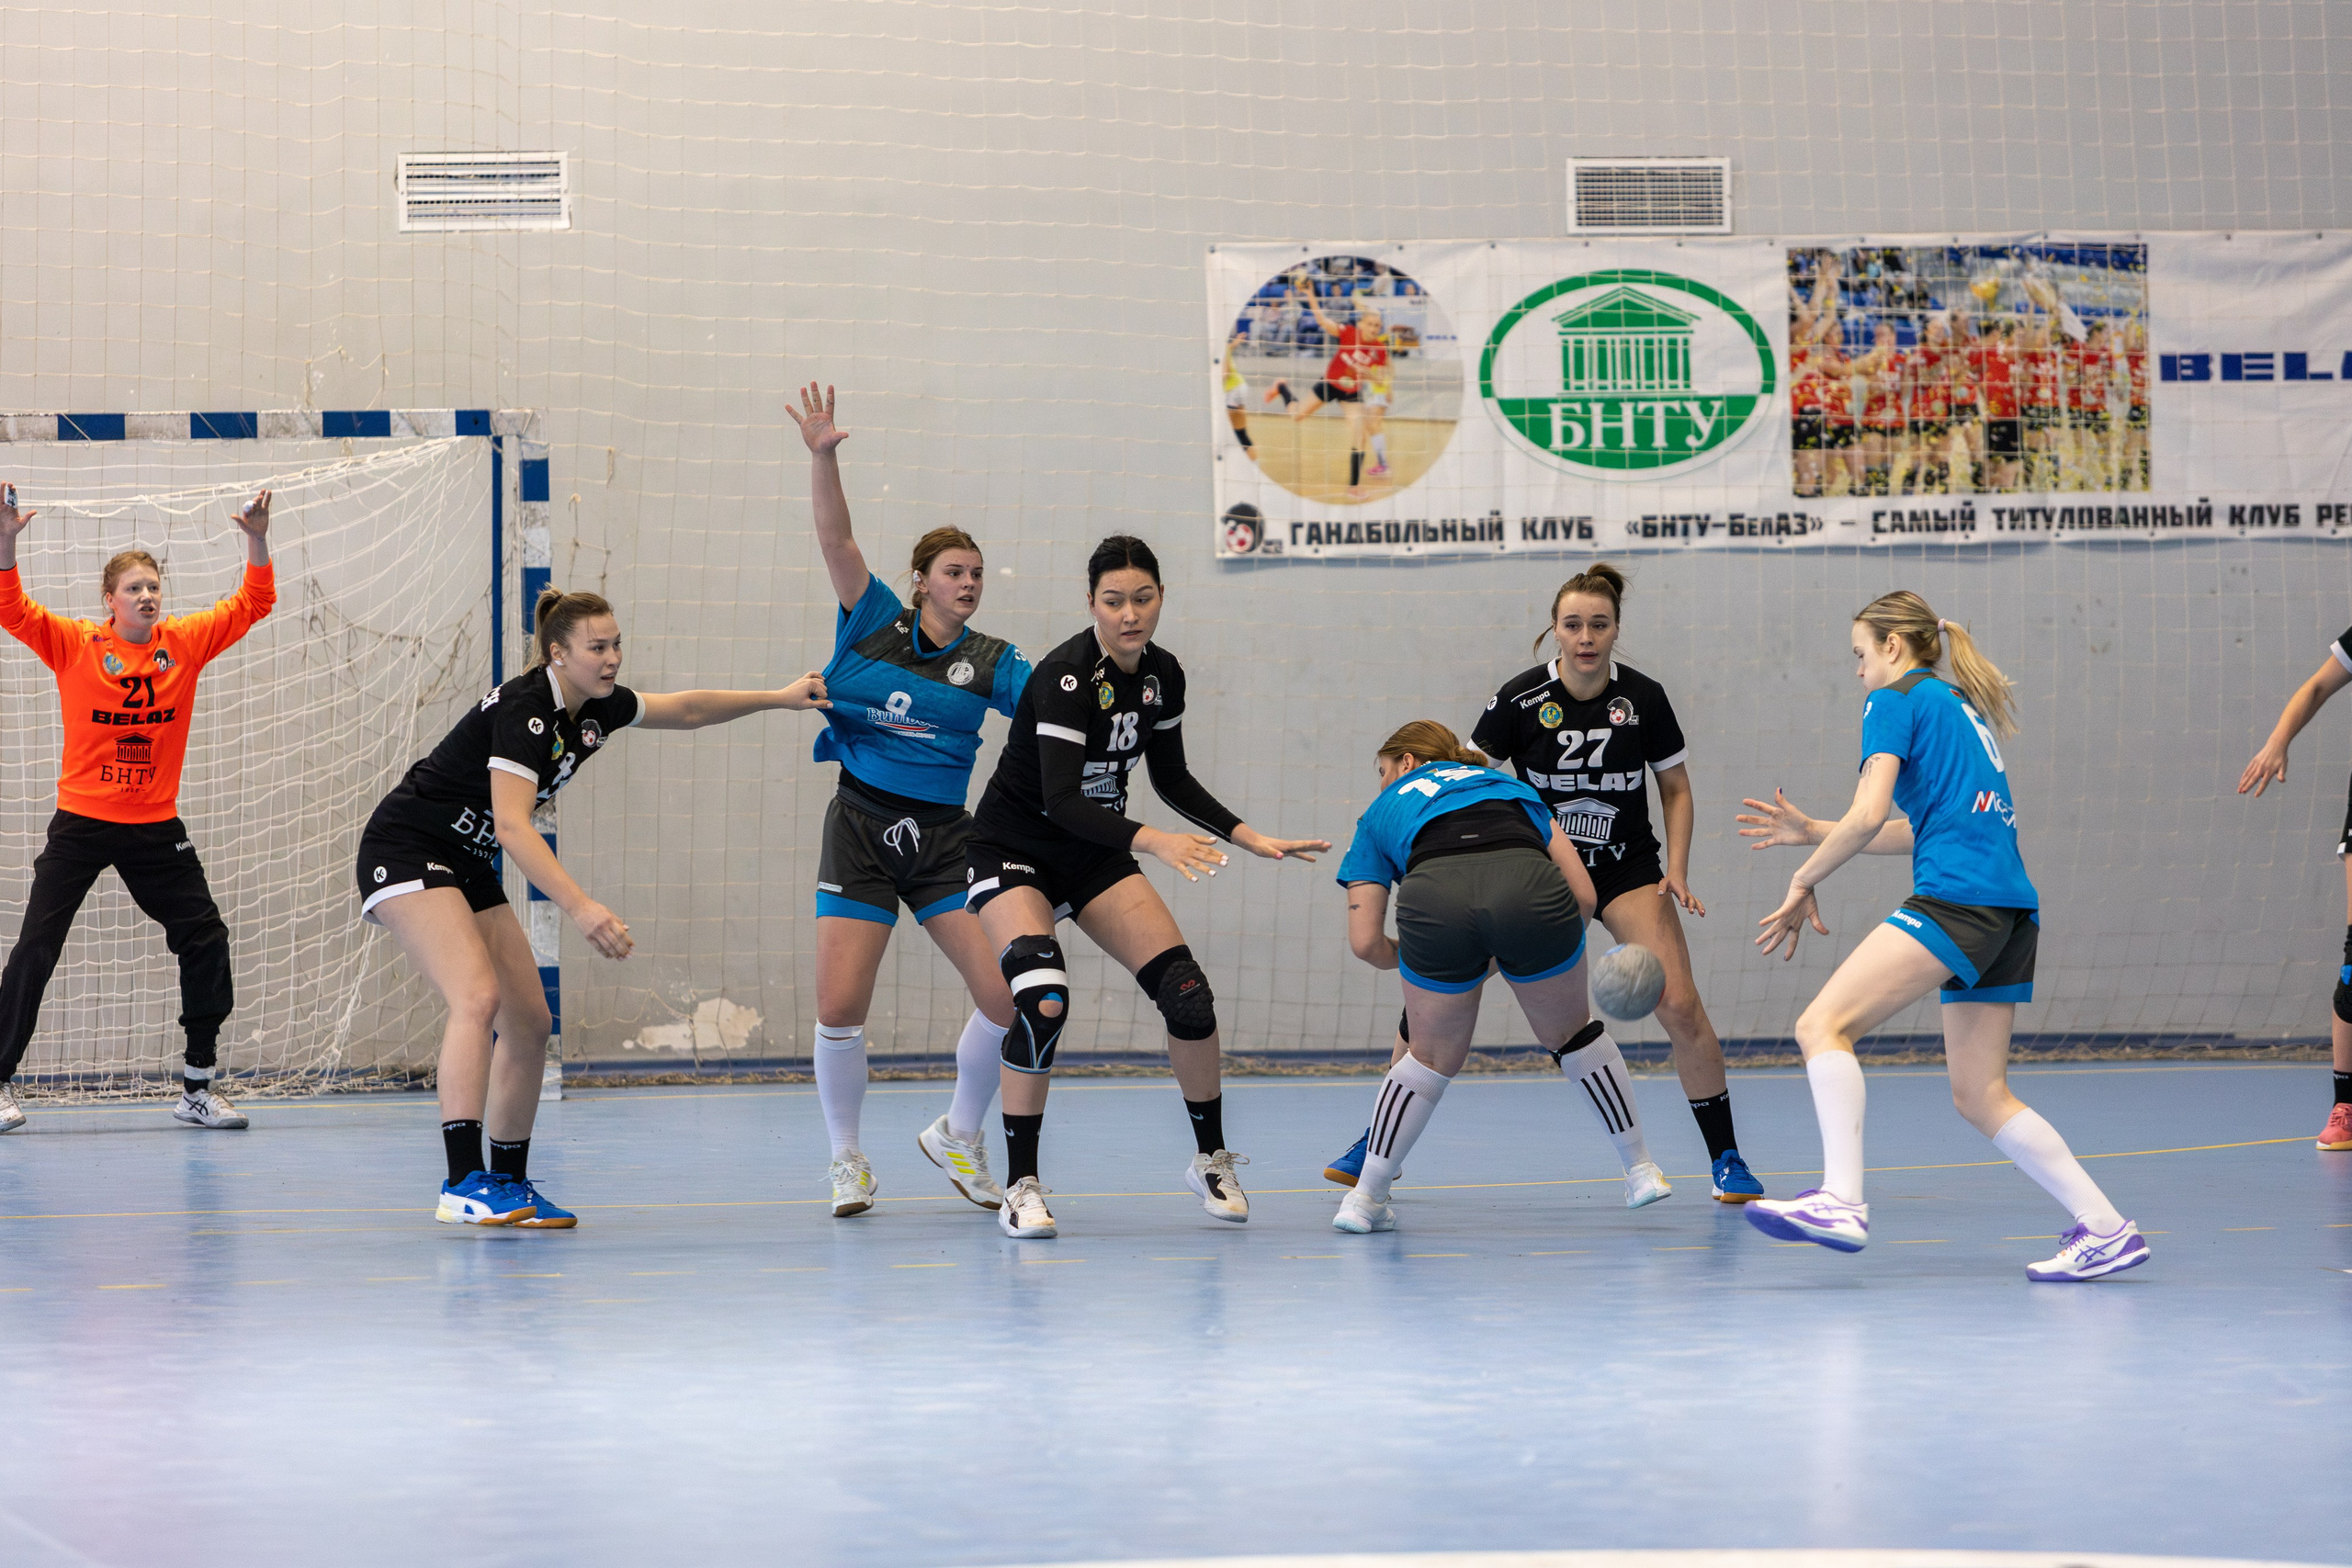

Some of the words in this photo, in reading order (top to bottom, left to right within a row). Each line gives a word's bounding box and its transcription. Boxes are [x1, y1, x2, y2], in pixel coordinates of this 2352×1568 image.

[1547, 400, 1724, 448] БНТУ
[1290, 509, 1504, 546] ГАНДБОЛЬНЫЙ
[1521, 515, 1594, 540] КЛУБ
[1872, 500, 1975, 534] САМЫЙ
[1992, 496, 2212, 531] ТИТУЛОВАННЫЙ
[2229, 503, 2300, 527] КЛУБ
[2316, 502, 2352, 528] РЕ
[119, 675, 155, 709] 21
[1519, 690, 1551, 709] Kempa
[92, 706, 175, 726] BELAZ
[1106, 711, 1139, 751] 18
[1556, 728, 1612, 770] 27
[1961, 702, 2005, 773] 6
[100, 764, 157, 785] БНТУ
[1526, 766, 1644, 792] BELAZ
[1002, 862, 1035, 874] Kempa
[1893, 909, 1923, 929] Kempa
